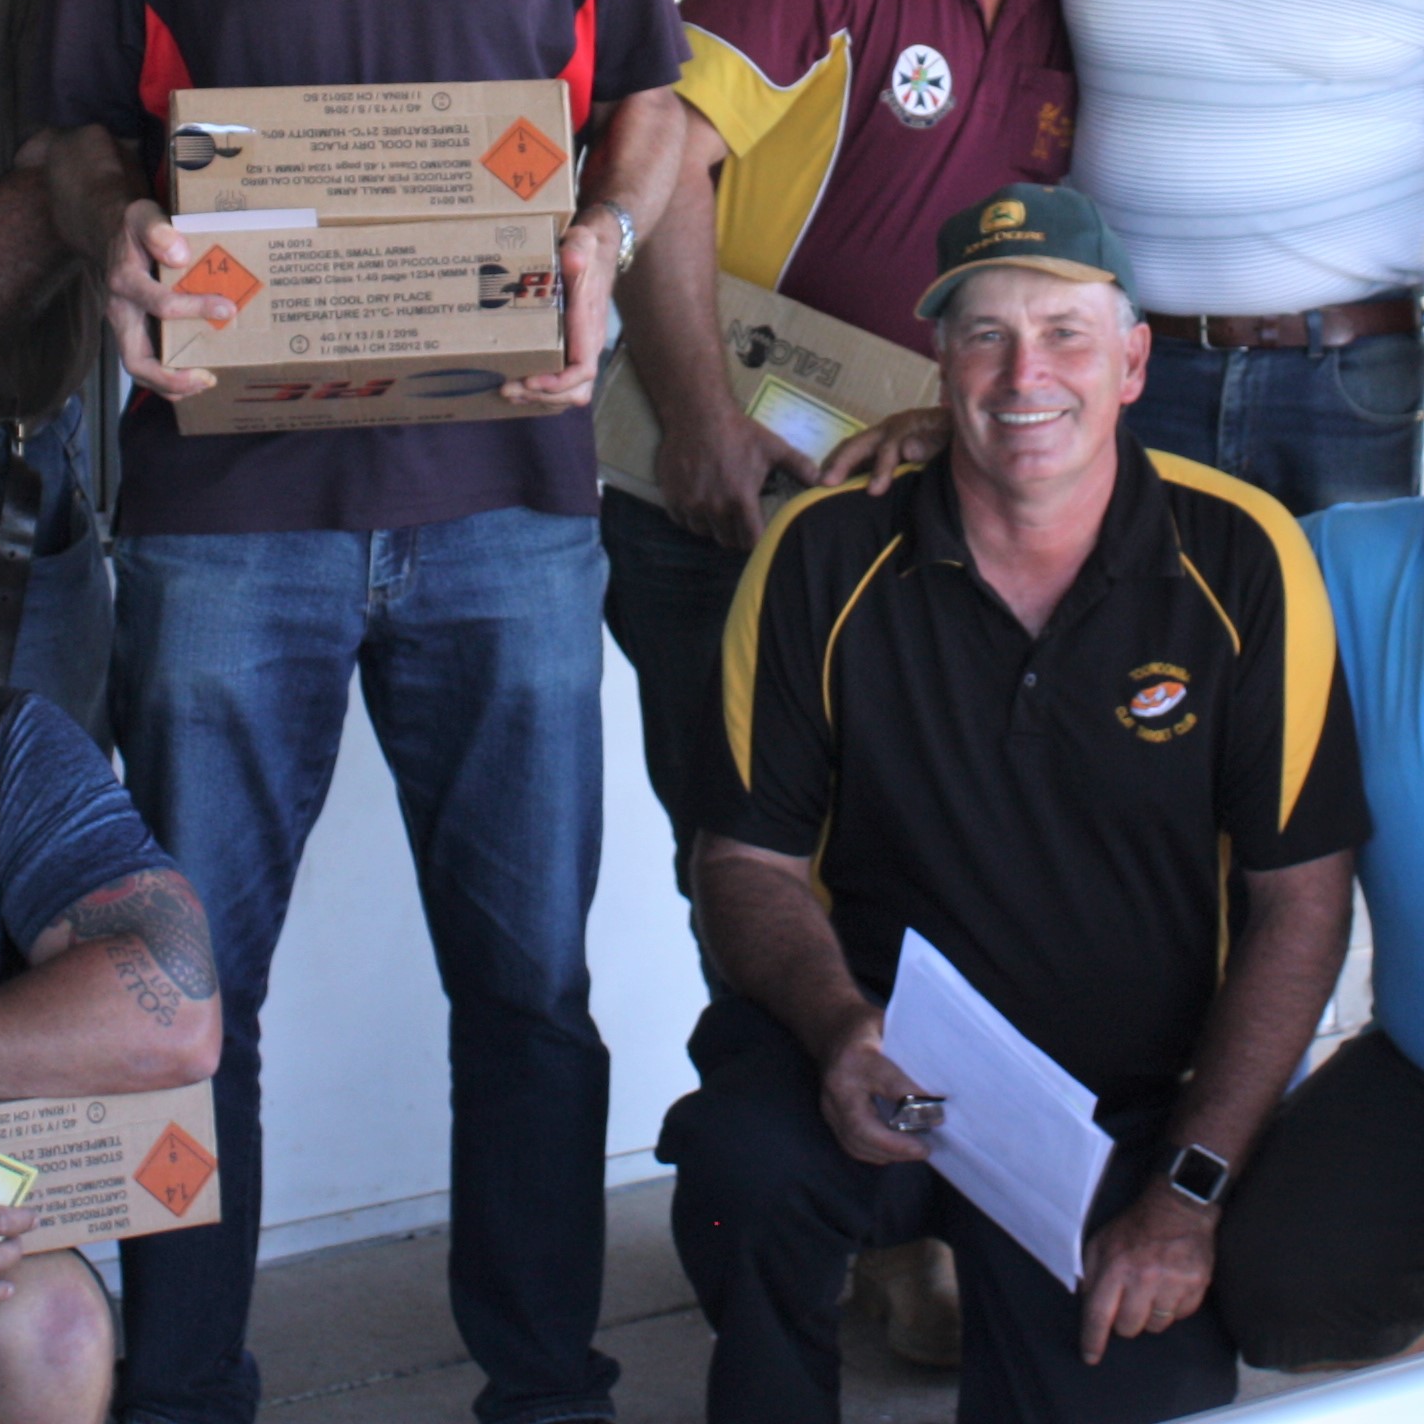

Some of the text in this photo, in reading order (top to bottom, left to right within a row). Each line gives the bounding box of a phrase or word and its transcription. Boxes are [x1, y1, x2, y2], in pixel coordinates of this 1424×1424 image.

[287, 128, 346, 139] HUMIDITY
[382, 124, 470, 136] TEMPERATURE
[309, 137, 471, 152] STORE IN COOL DRY PLACE
[345, 248, 382, 258] SMALL
[384, 245, 416, 256] ARMS
[205, 257, 229, 276] 1.4
[269, 262, 332, 274] CARTUCCE
[332, 261, 355, 271] PER
[400, 255, 451, 267] PICCOLO
[451, 253, 502, 265] CALIBRO
[270, 291, 433, 310] STORE IN COOL DRY PLACE
[271, 308, 360, 323] TEMPERATURE
[396, 303, 456, 317] HUMIDITY
[13, 1110, 30, 1122] CH
[37, 1104, 66, 1118] RINA
[38, 1135, 123, 1158] TEMPERATURE
[69, 1158, 83, 1168] IN
[83, 1150, 124, 1166] STORE
[69, 1189, 128, 1205] CARTUCCE
[165, 1182, 189, 1204] 1.4
[45, 1201, 67, 1211] PER
